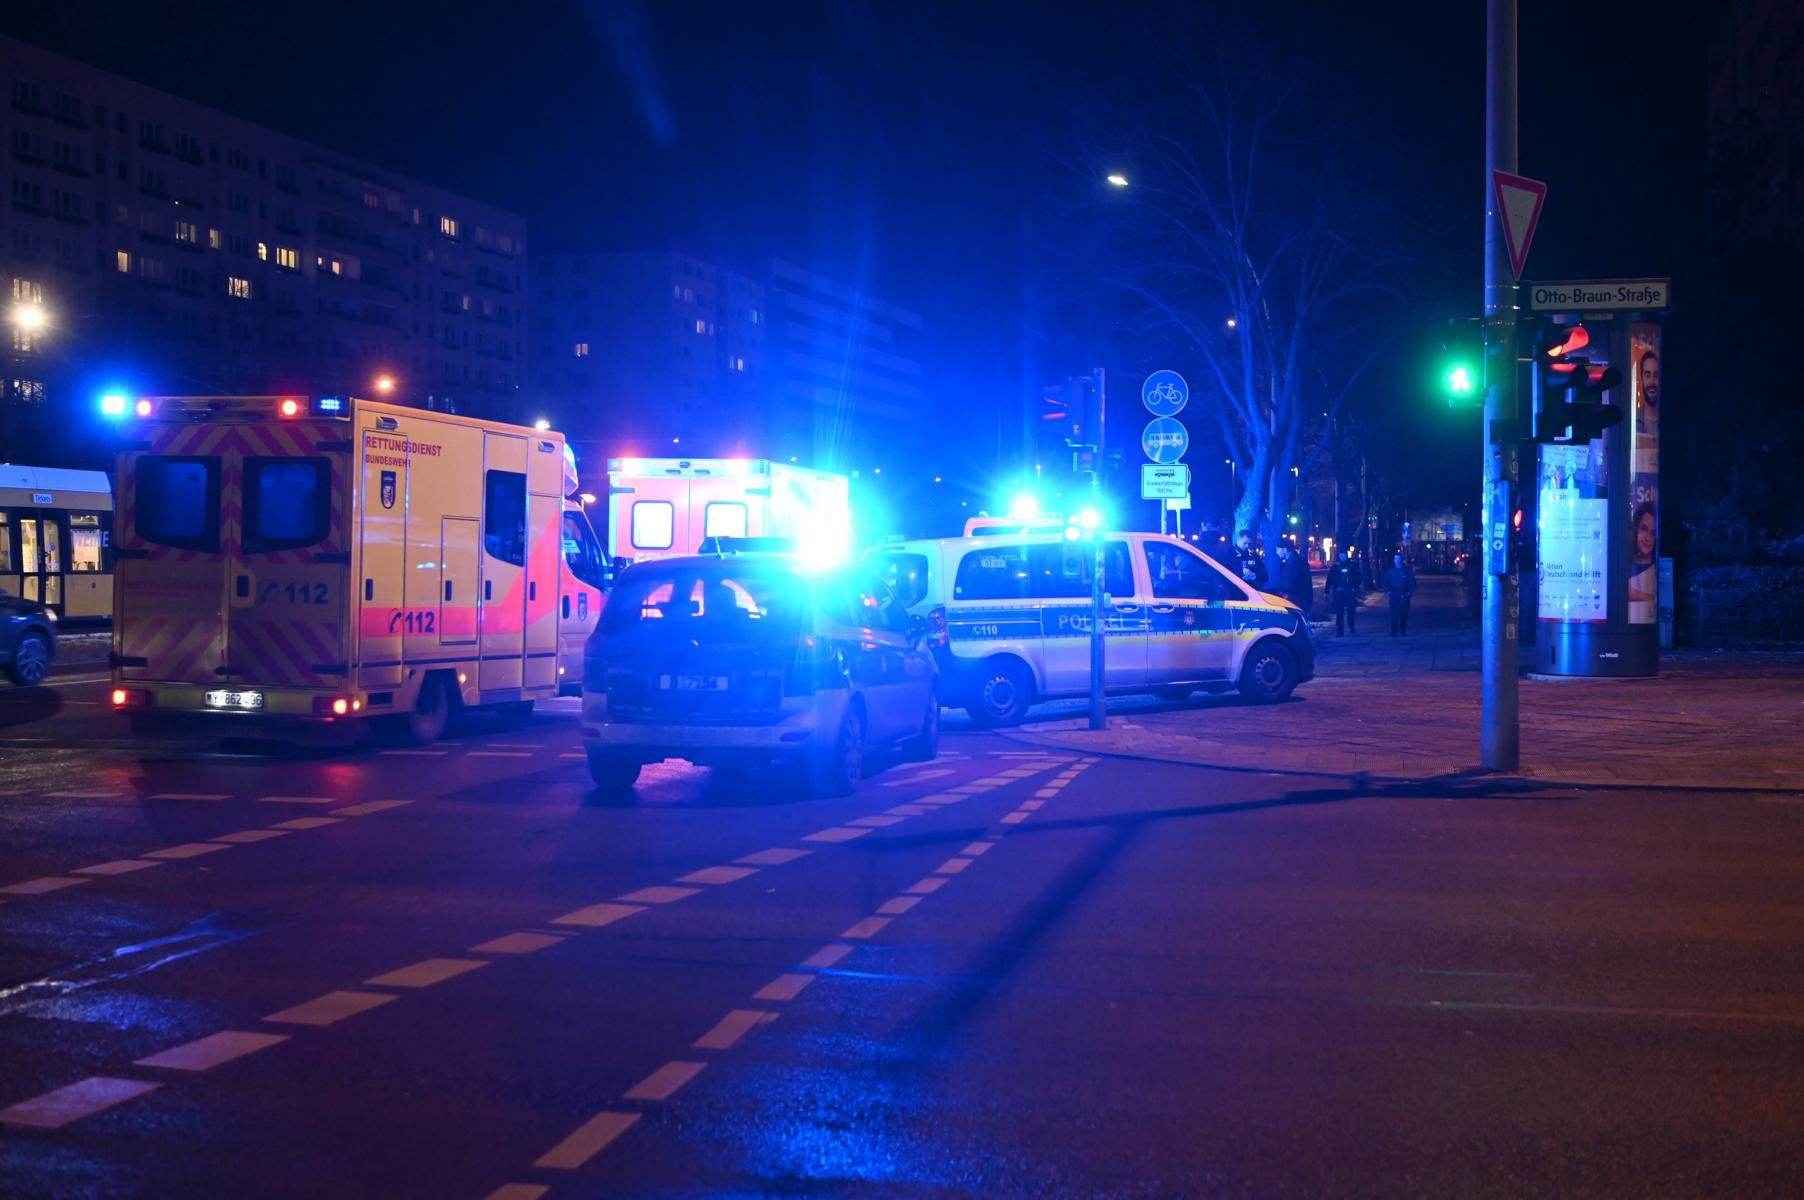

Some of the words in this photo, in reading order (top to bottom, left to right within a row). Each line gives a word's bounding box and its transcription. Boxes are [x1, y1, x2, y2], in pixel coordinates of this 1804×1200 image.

[1535, 287, 1661, 304] Otto-Braun-Straße
[366, 436, 442, 457] RETTUNGSDIENST
[284, 582, 329, 605] 112
[406, 611, 435, 633] 112
[980, 625, 998, 635] 110
[1059, 614, 1124, 630] POLEI
